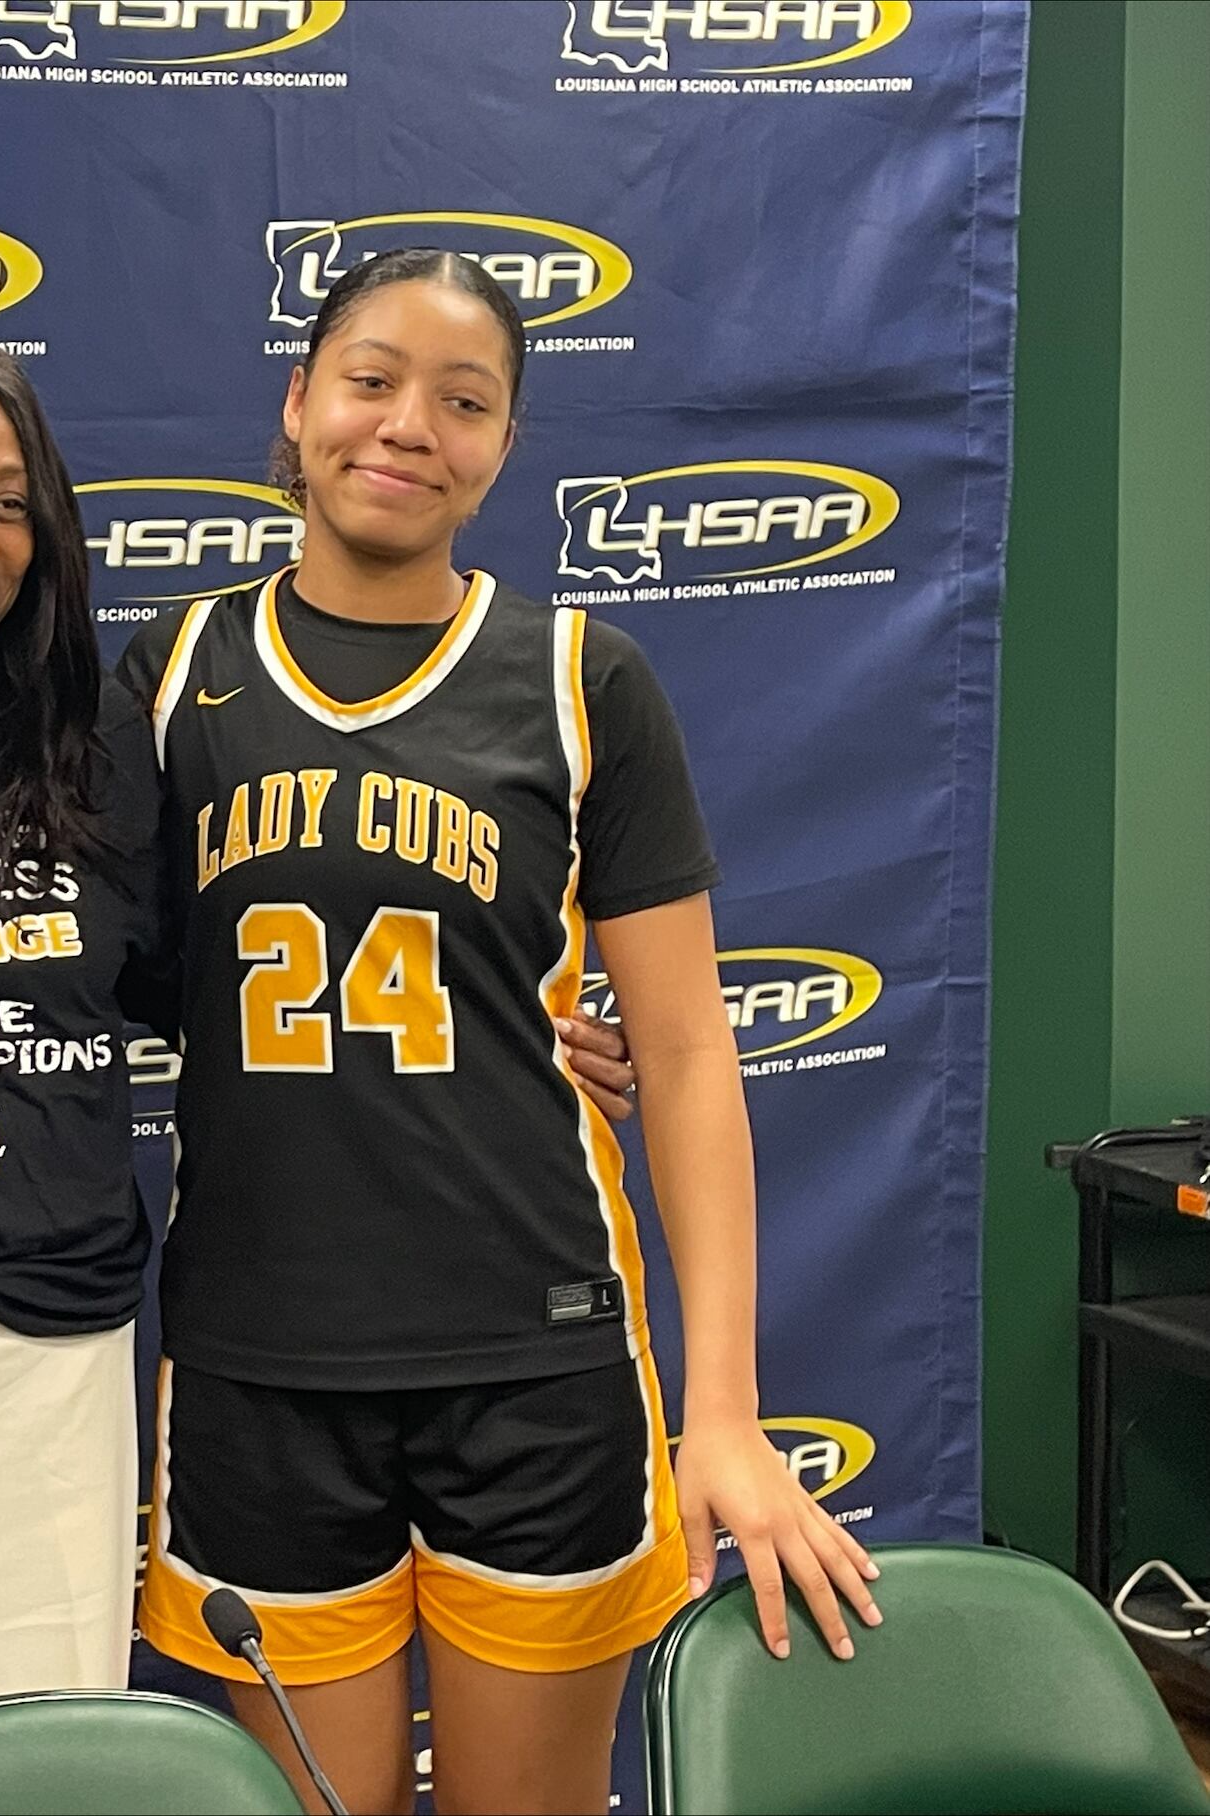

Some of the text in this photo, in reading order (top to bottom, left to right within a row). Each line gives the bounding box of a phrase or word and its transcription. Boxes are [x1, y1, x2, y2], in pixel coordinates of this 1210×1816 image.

[45, 67, 87, 83] HIGH
[91, 69, 157, 86] SCHOOL
[161, 71, 238, 87] ATHLETIC
[242, 71, 347, 87] ASSOCIATION
[555, 77, 913, 94] LOUISIANA HIGH SCHOOL ATHLETIC ASSOCIATION
[264, 341, 310, 355] LOUIS
[535, 337, 634, 352] ASSOCIATION
[587, 492, 866, 552] LHSAA
[552, 569, 895, 606] LOUISIANA HIGH SCHOOL ATHLETIC ASSOCIATION
[97, 608, 158, 622] SCHOO
[197, 769, 501, 903] LADY CUBS
[236, 903, 455, 1073] 24
[740, 1045, 887, 1078] HLETIC ASSOCIATION
[602, 1288, 611, 1306] L
